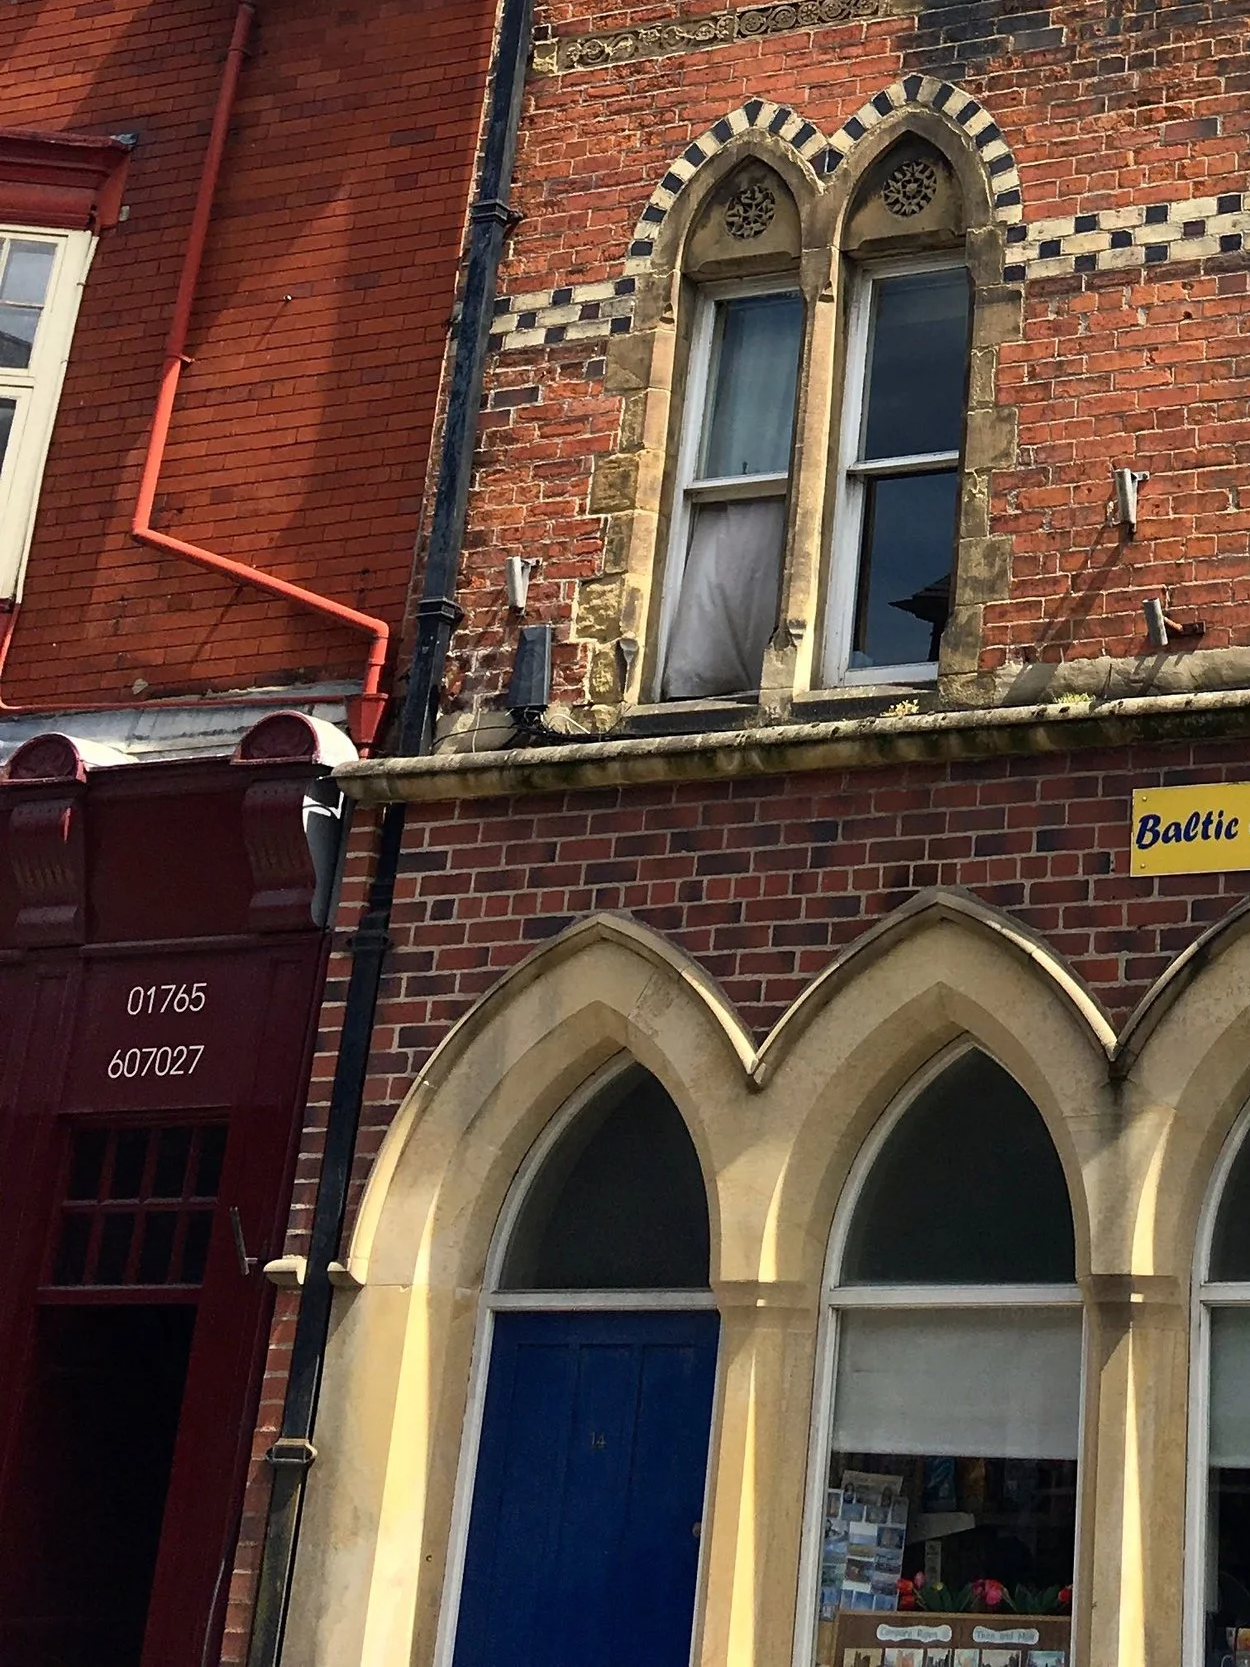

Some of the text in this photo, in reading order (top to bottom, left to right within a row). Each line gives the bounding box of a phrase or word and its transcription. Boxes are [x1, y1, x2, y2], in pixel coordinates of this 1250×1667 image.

[1136, 810, 1239, 850] Baltic
[127, 982, 208, 1016] 01765
[107, 1045, 206, 1079] 607027
